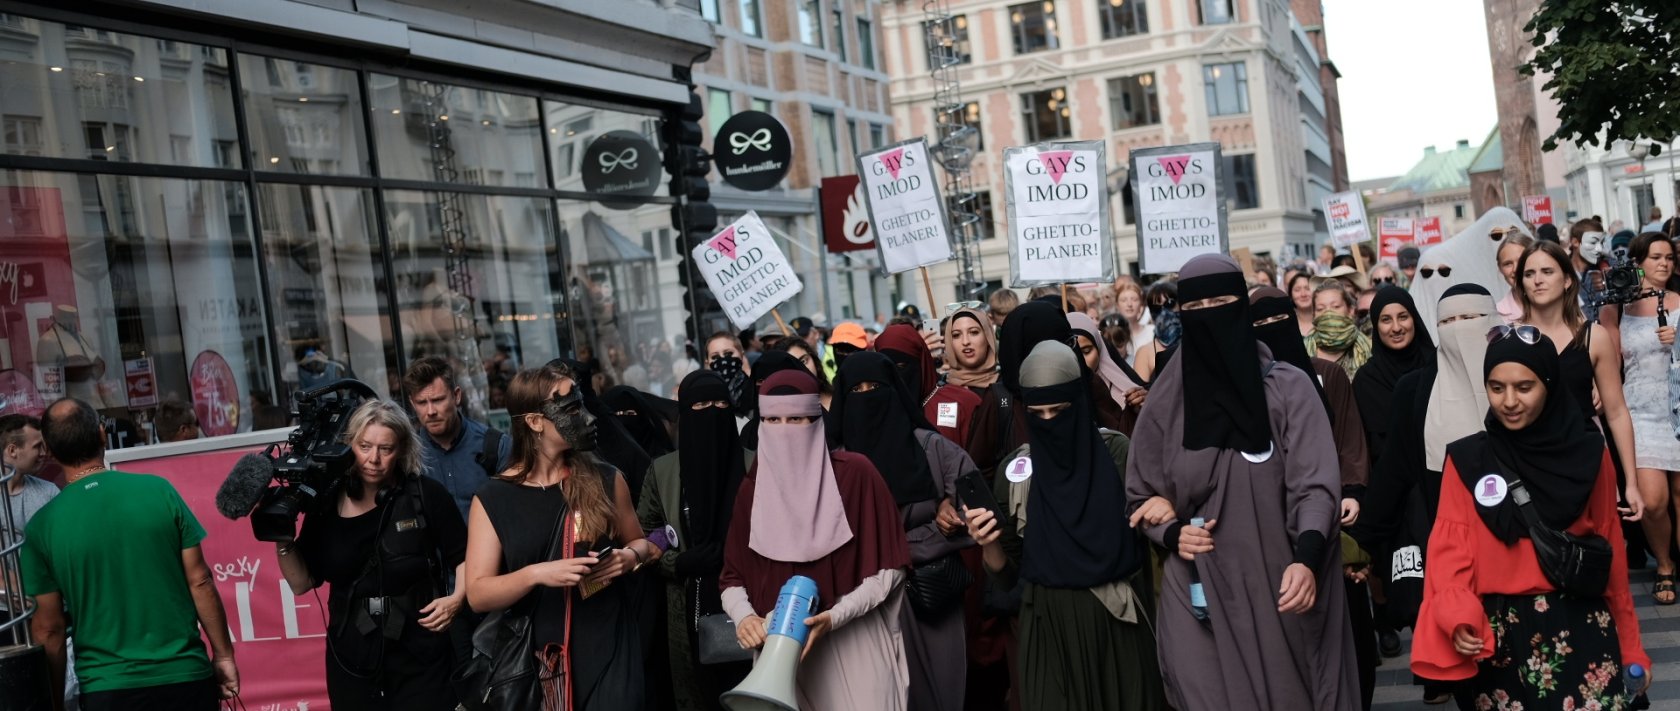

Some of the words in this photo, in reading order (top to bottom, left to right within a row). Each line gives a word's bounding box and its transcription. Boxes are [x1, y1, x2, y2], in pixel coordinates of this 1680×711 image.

[872, 150, 915, 176] GAYS
[1025, 156, 1086, 176] GAYS
[1148, 159, 1203, 178] GAYS
[877, 175, 921, 200] IMOD
[1026, 183, 1089, 203] IMOD
[1150, 183, 1206, 201] IMOD
[882, 208, 935, 232] GHETTO-
[1147, 216, 1216, 232] GHETTO-
[887, 225, 939, 248] PLANER!
[1023, 223, 1099, 241] GHETTO-
[1150, 234, 1216, 250] PLANER!
[704, 225, 750, 264] GAYS
[1025, 243, 1099, 261] PLANER!
[715, 247, 763, 287] IMOD
[724, 262, 780, 303] GHETTO-
[733, 274, 790, 318] PLANER!
[214, 556, 260, 592] sexy
